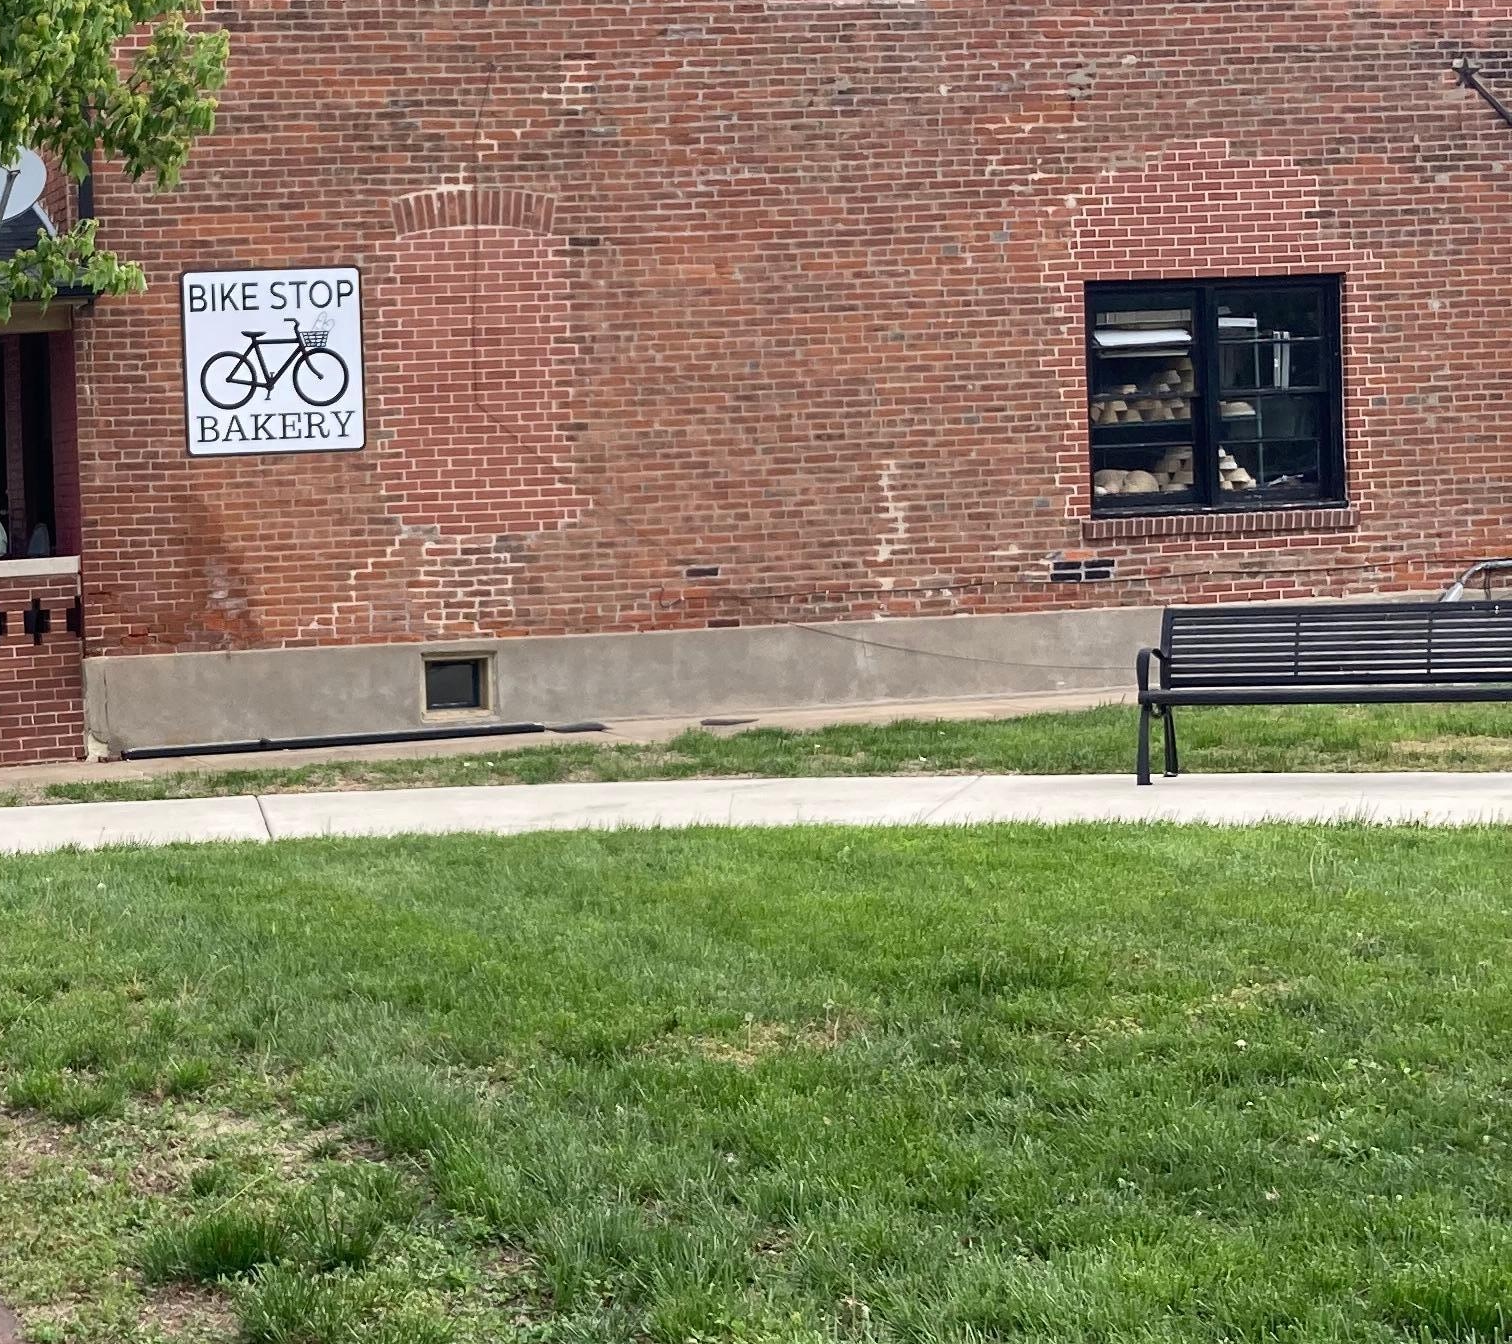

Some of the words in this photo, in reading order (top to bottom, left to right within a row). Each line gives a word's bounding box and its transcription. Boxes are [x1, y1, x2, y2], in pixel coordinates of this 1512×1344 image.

[189, 281, 260, 313] BIKE
[269, 279, 355, 310] STOP
[196, 410, 356, 443] BAKERY
